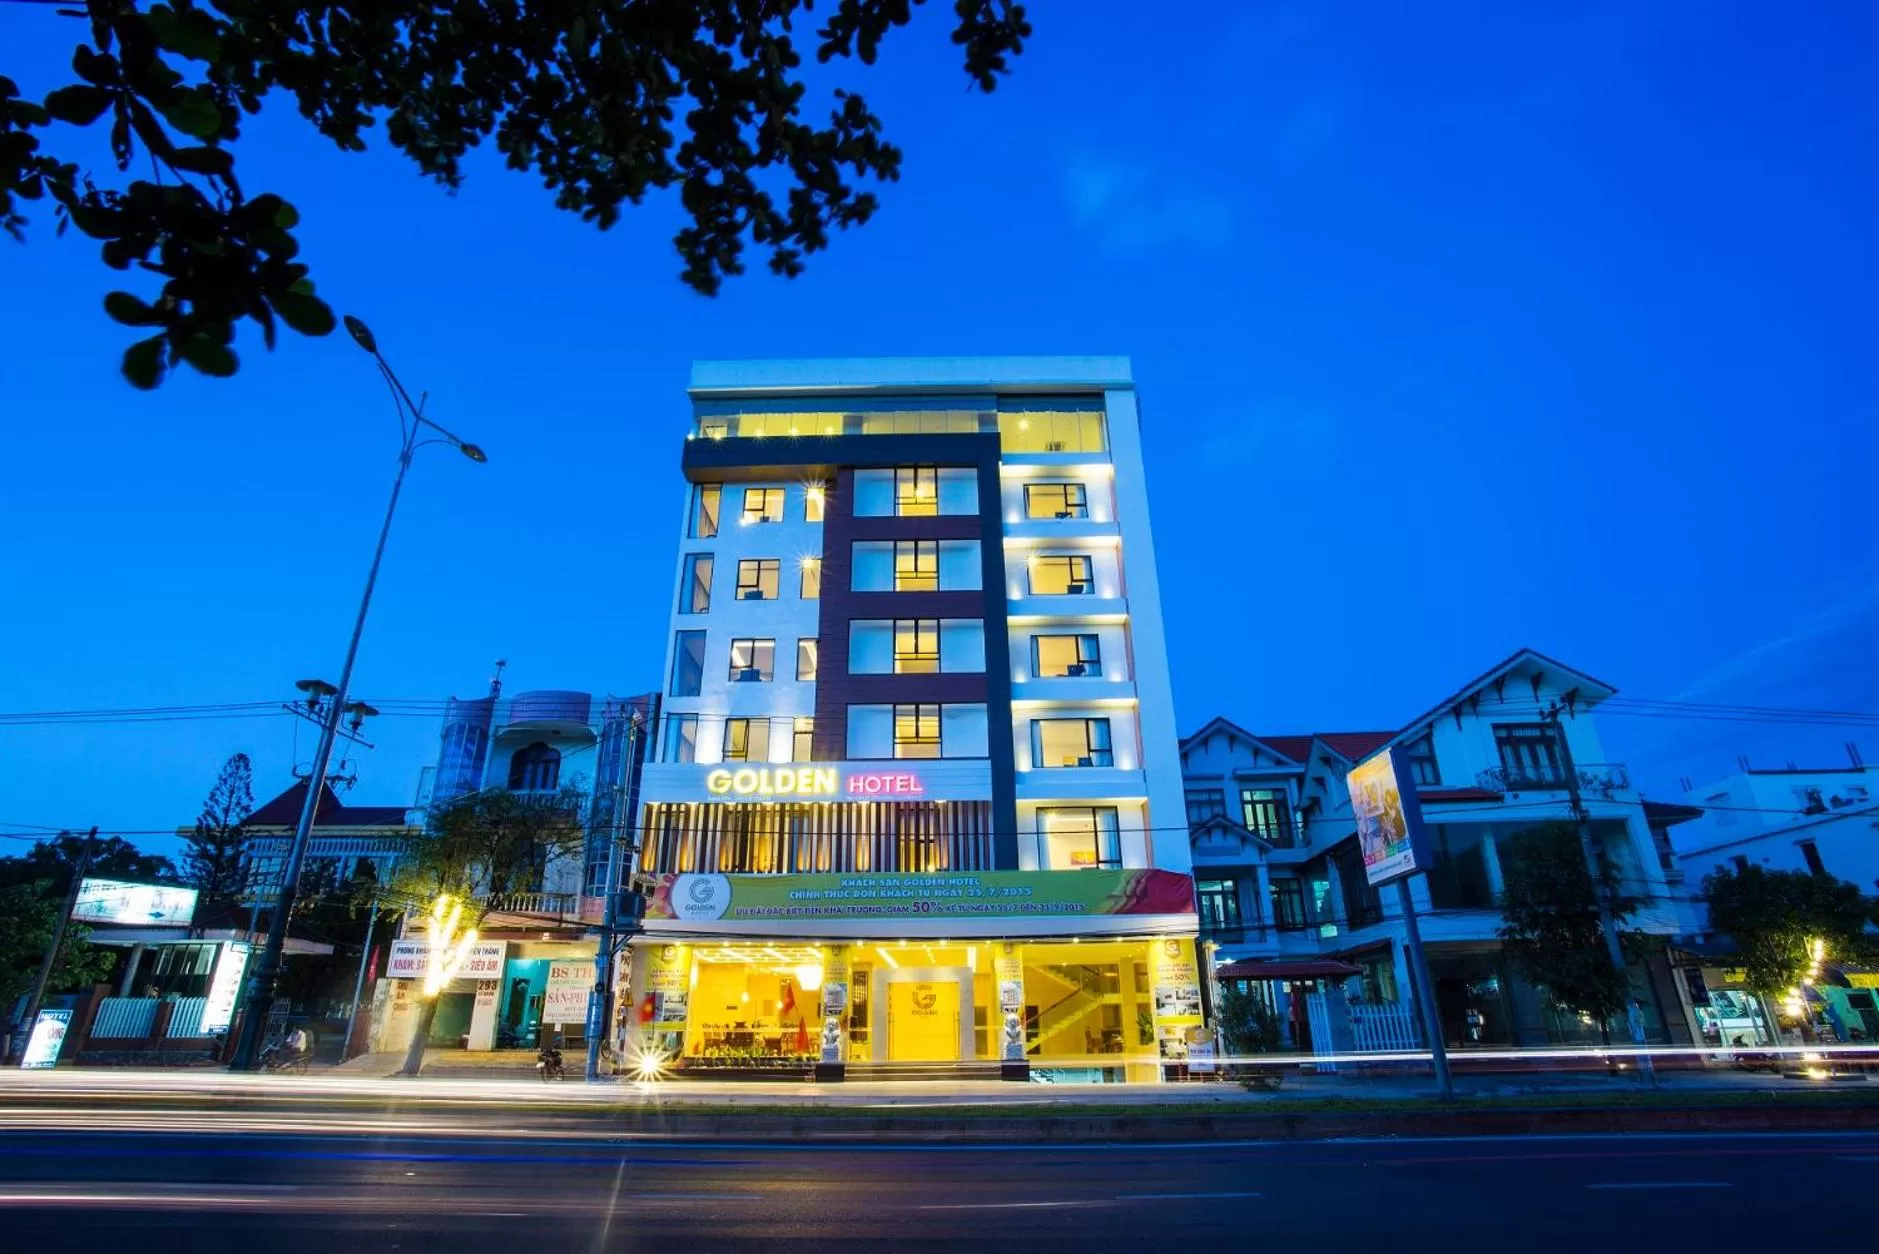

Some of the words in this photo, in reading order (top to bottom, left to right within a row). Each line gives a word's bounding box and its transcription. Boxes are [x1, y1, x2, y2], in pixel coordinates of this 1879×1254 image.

[707, 769, 837, 794] GOLDEN
[850, 775, 922, 793] HOTEL
[904, 877, 945, 886] GOLDEN
[949, 876, 981, 886] HOTEL
[913, 901, 944, 913] 50%
[551, 967, 569, 978] BS
[478, 980, 498, 991] 293
